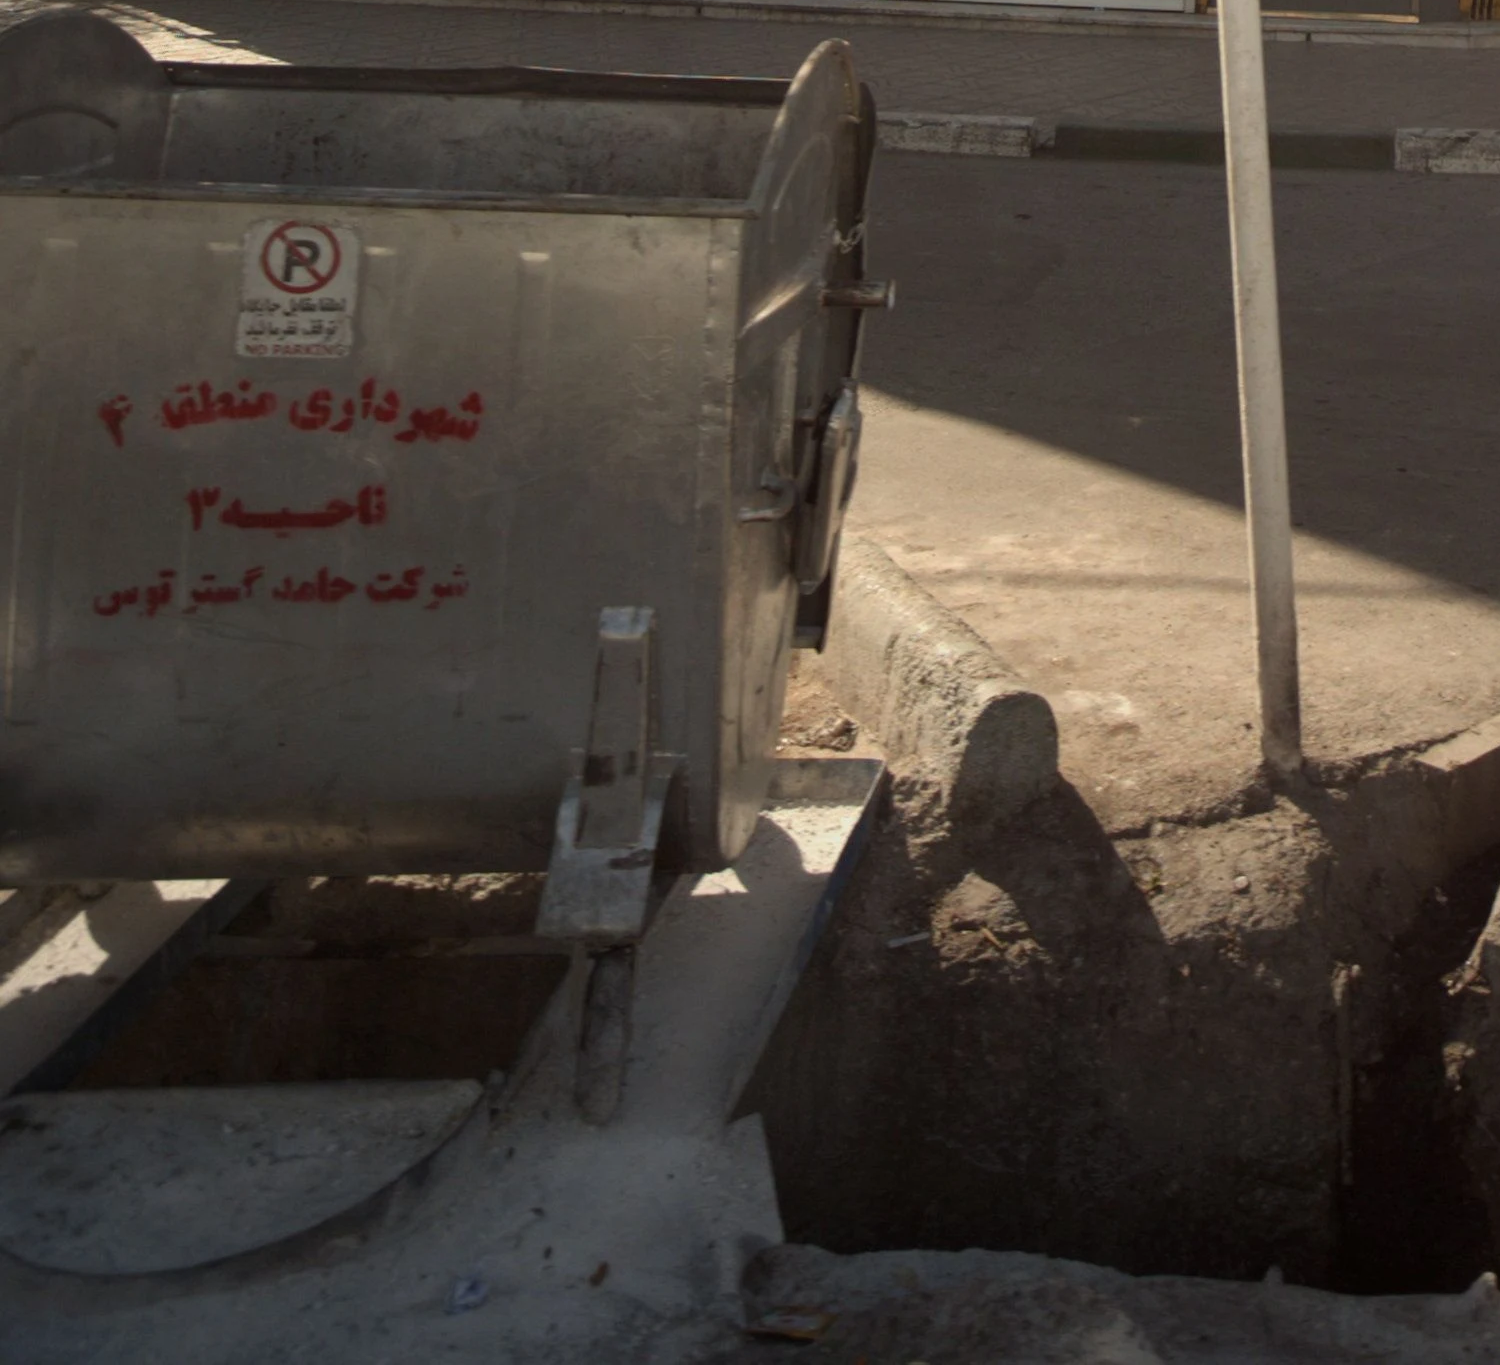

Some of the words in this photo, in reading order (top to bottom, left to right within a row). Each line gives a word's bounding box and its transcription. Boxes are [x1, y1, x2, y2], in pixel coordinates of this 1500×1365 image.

[289, 376, 486, 443] شهرداری
[271, 565, 358, 603] حامد
[365, 563, 470, 612] شرکت
